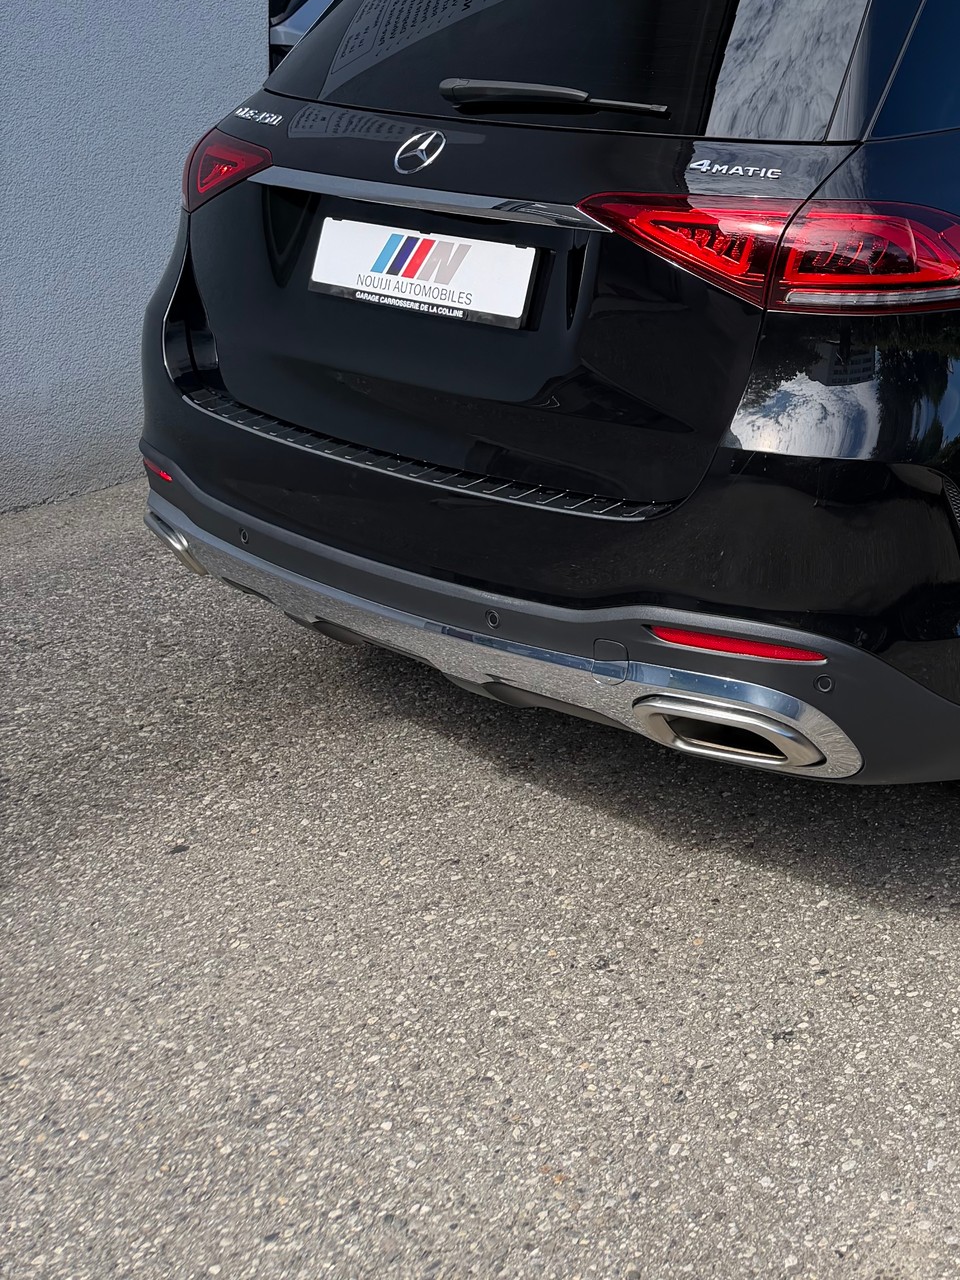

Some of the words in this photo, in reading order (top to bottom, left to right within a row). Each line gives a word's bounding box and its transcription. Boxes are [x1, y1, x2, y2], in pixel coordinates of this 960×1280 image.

[689, 159, 782, 179] 4MATIC
[355, 290, 379, 303] GARAGE
[380, 295, 419, 311] CARROSSERIE
[420, 302, 429, 312] DE
[429, 305, 438, 314] LA
[438, 307, 464, 318] COLLINE
[356, 274, 392, 291] NOUIJI
[393, 280, 472, 306] AUTOMOBILES
